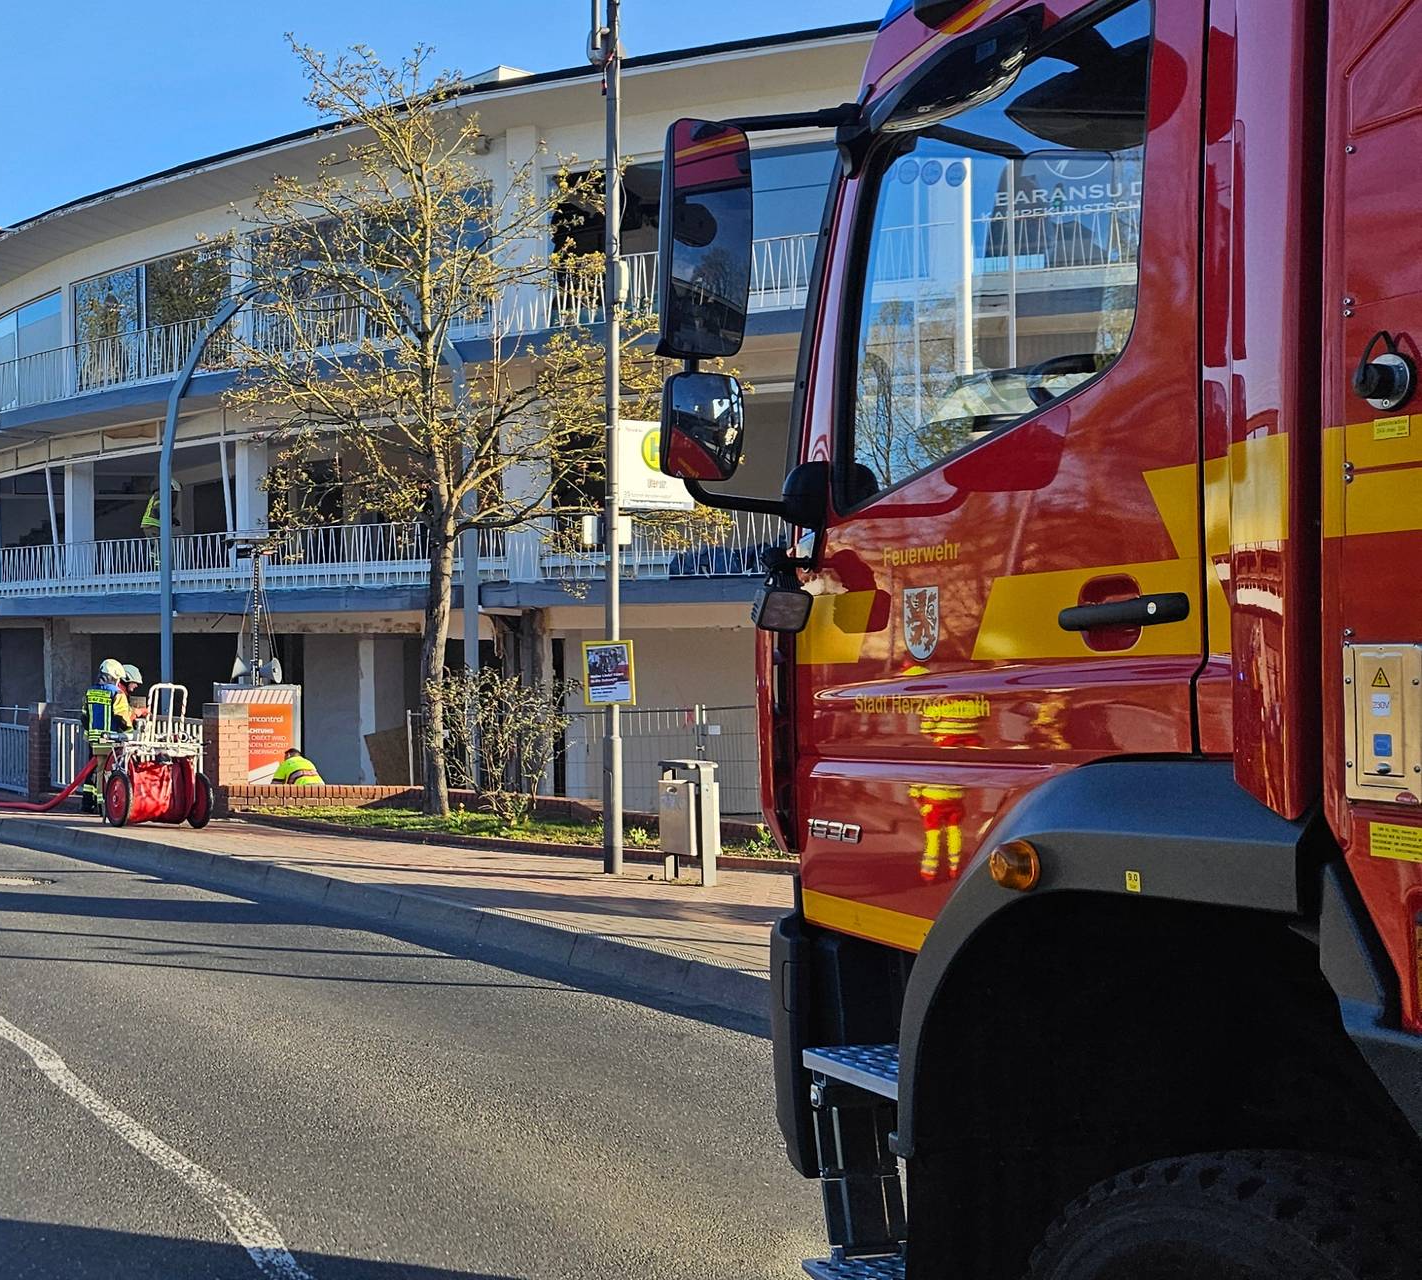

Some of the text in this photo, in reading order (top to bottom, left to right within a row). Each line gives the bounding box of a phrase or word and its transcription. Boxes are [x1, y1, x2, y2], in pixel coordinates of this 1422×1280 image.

[994, 184, 1123, 207] BARANSU
[883, 539, 960, 568] Feuerwehr
[855, 694, 990, 721] Stadt Herzogenrath
[807, 818, 861, 844] 1530
